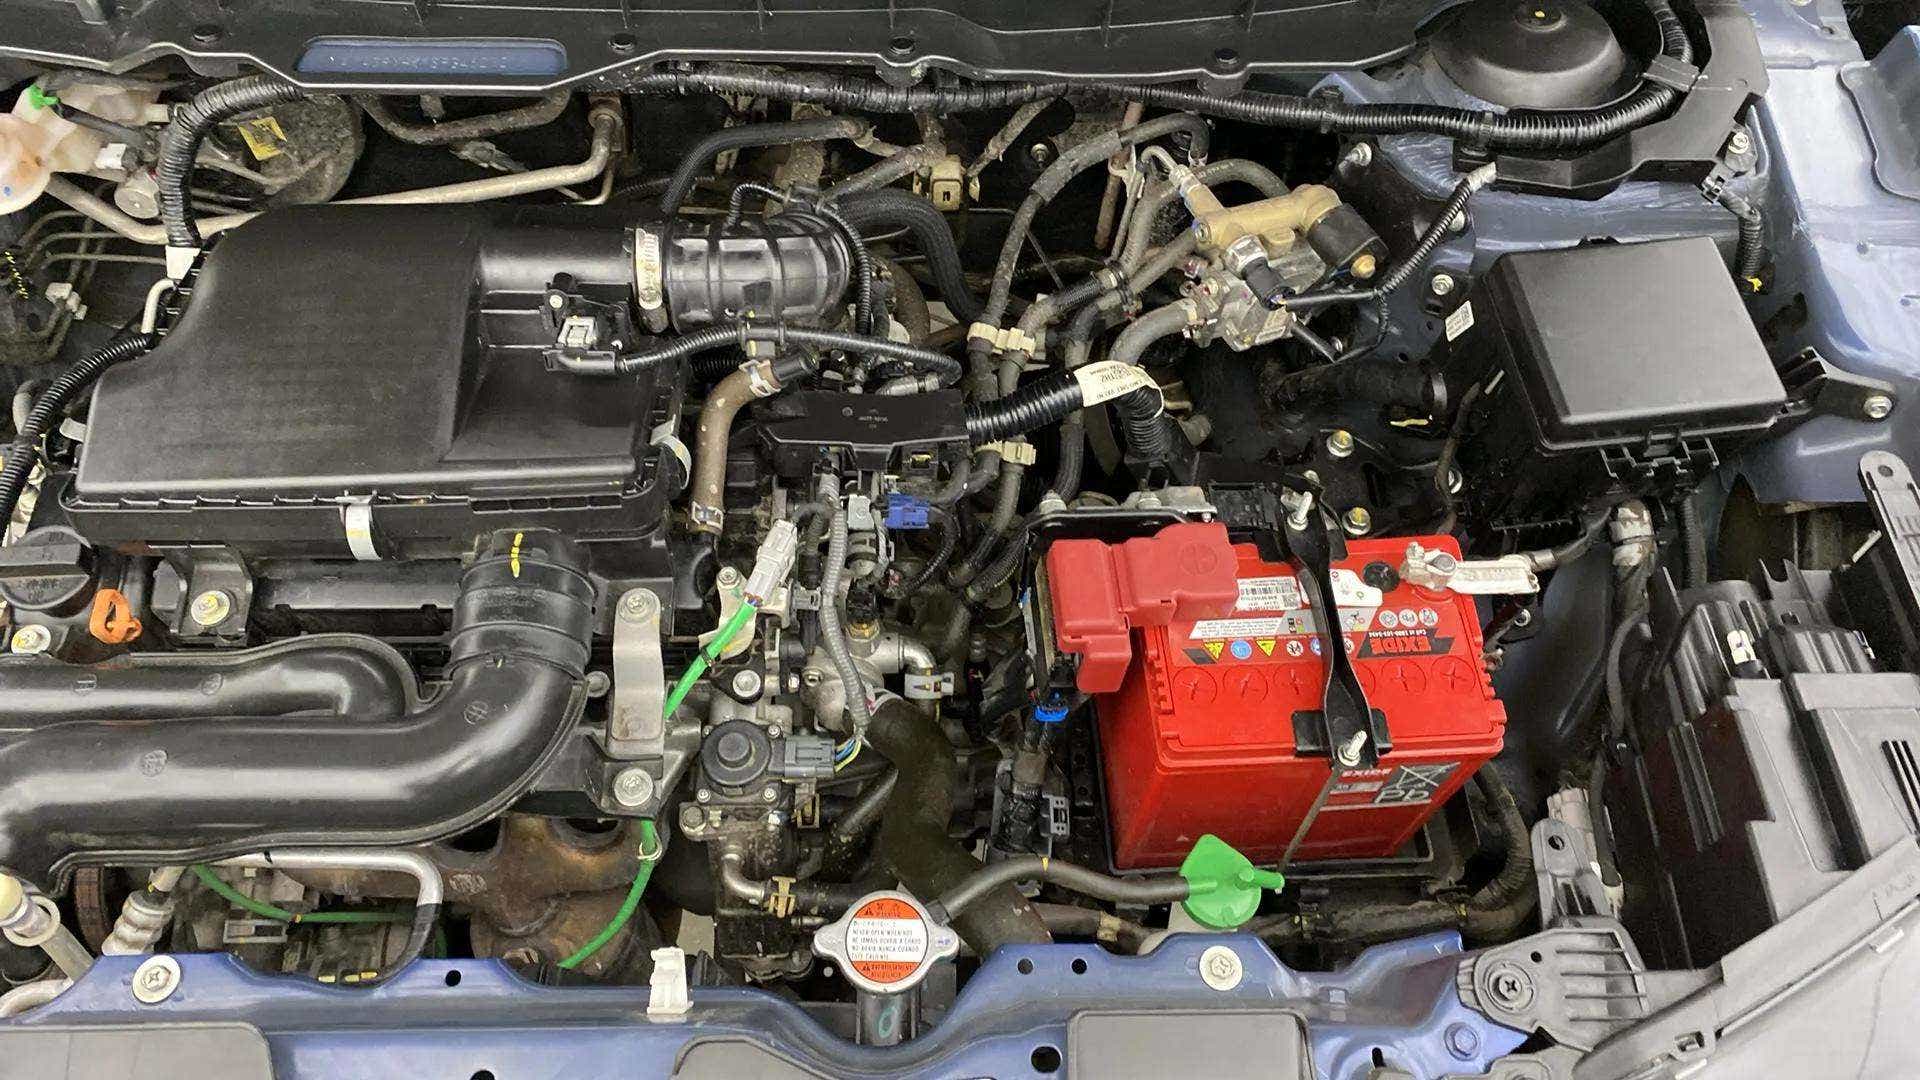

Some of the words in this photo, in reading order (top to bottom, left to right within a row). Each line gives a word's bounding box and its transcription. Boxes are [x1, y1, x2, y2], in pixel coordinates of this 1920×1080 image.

[1369, 636, 1432, 655] EXIDE
[1342, 767, 1392, 777] EXIDE
[1374, 789, 1429, 803] Pb
